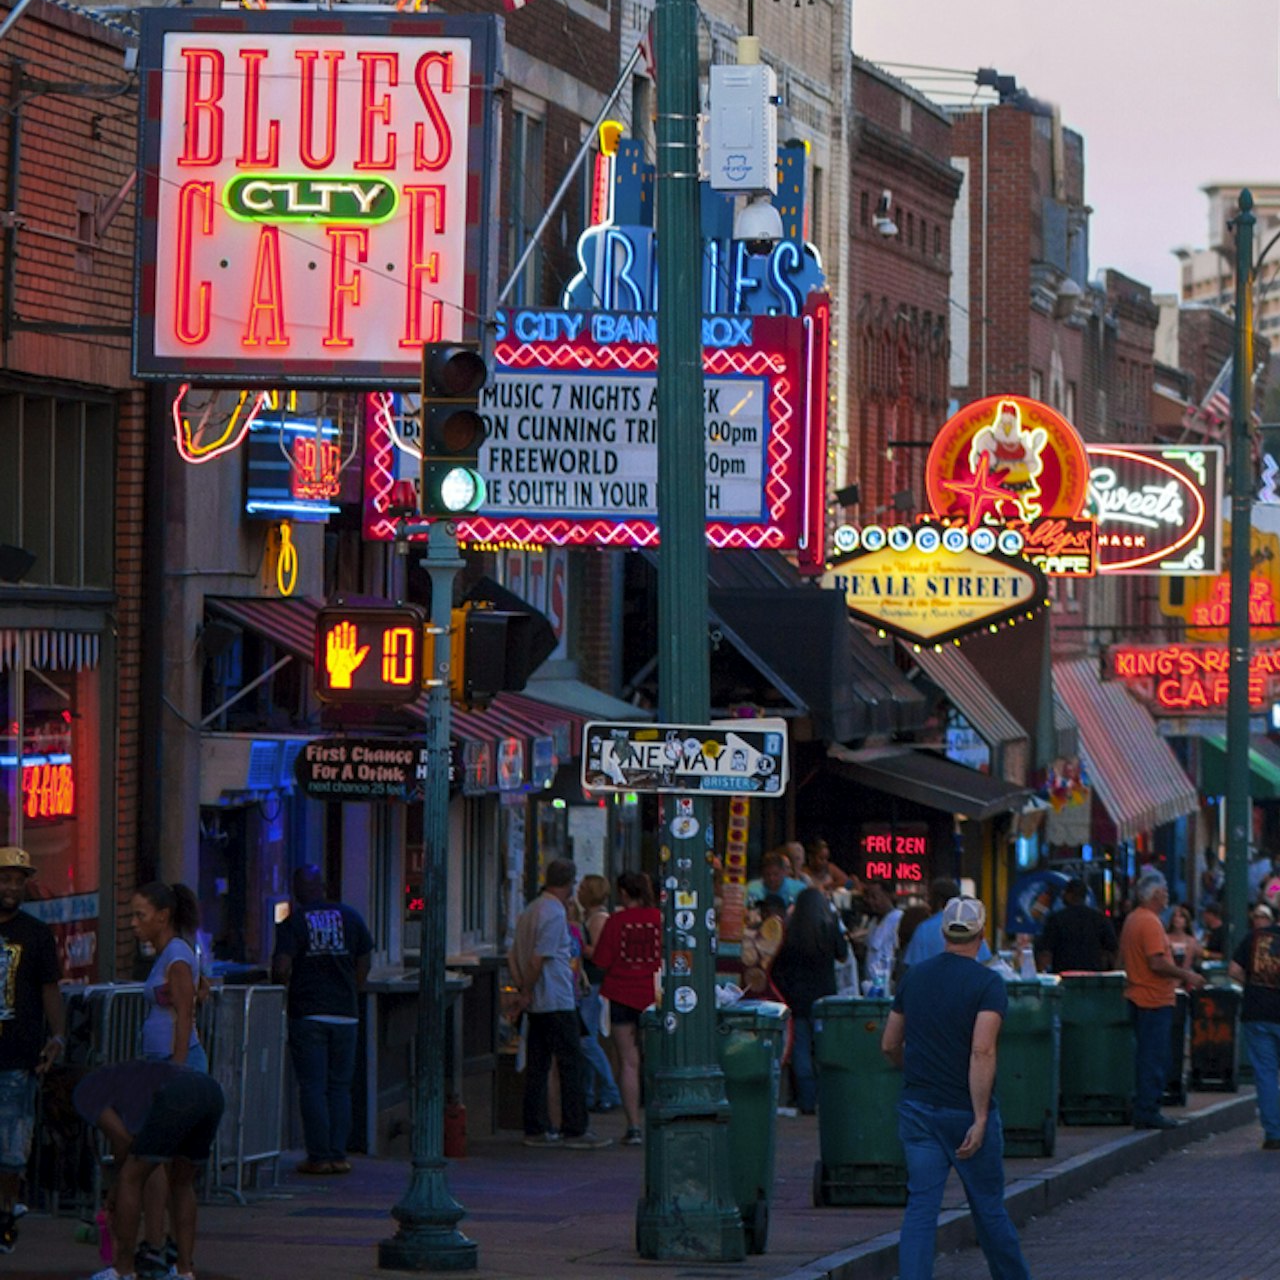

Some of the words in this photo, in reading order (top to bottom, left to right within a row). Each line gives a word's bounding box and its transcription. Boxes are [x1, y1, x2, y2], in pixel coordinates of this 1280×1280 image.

[177, 47, 455, 171] BLUES
[241, 182, 386, 213] CITY
[174, 180, 447, 348] CAFE
[515, 310, 584, 342] CITY
[483, 383, 544, 410] MUSIC
[550, 384, 563, 409] 7
[569, 385, 642, 412] NIGHTS
[516, 416, 617, 443] CUNNING
[488, 447, 618, 475] FREEWORLD
[508, 480, 566, 506] SOUTH
[572, 482, 593, 507] IN
[600, 482, 649, 508] YOUR
[1089, 466, 1185, 528] Sweets
[833, 575, 916, 598] BEALE
[925, 575, 1023, 598] STREET
[383, 627, 414, 685] 10
[306, 745, 347, 763] First
[351, 746, 414, 763] Chance
[312, 763, 339, 781] For
[341, 764, 354, 781] A
[358, 764, 406, 782] Drink
[332, 782, 370, 794] chance
